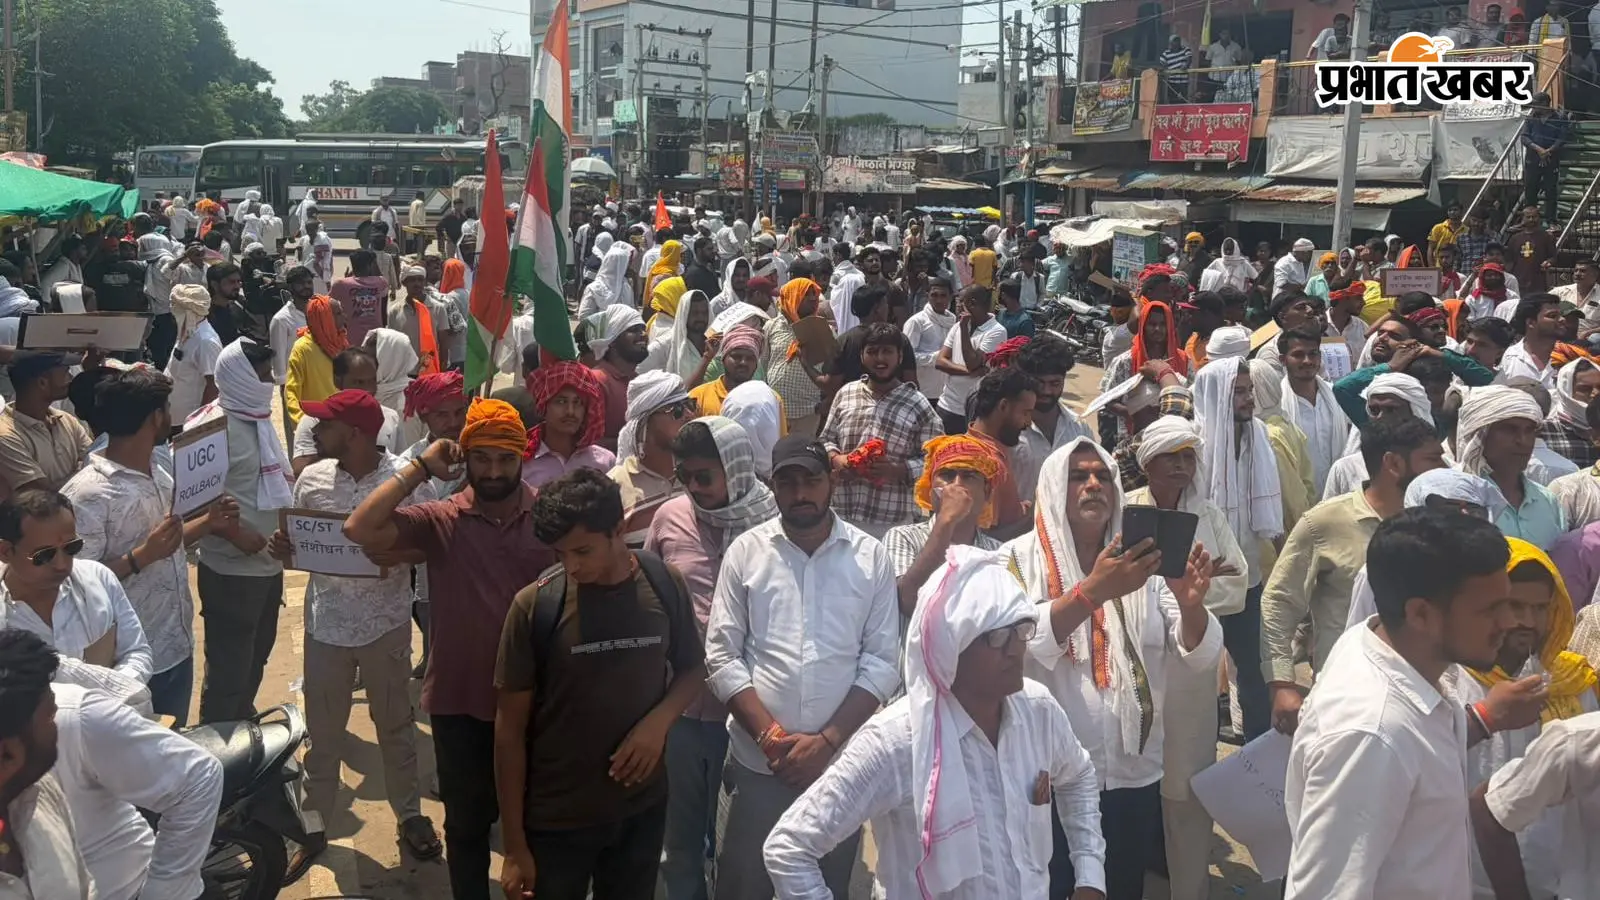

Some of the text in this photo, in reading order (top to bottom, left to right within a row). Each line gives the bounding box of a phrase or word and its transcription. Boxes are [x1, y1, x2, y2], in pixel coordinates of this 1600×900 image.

[888, 159, 916, 171] भण्डार
[308, 187, 358, 199] HANTI
[187, 443, 216, 472] UGC
[179, 471, 223, 501] ROLLBACK
[295, 519, 333, 534] SC/ST
[300, 539, 345, 555] संशोधन
